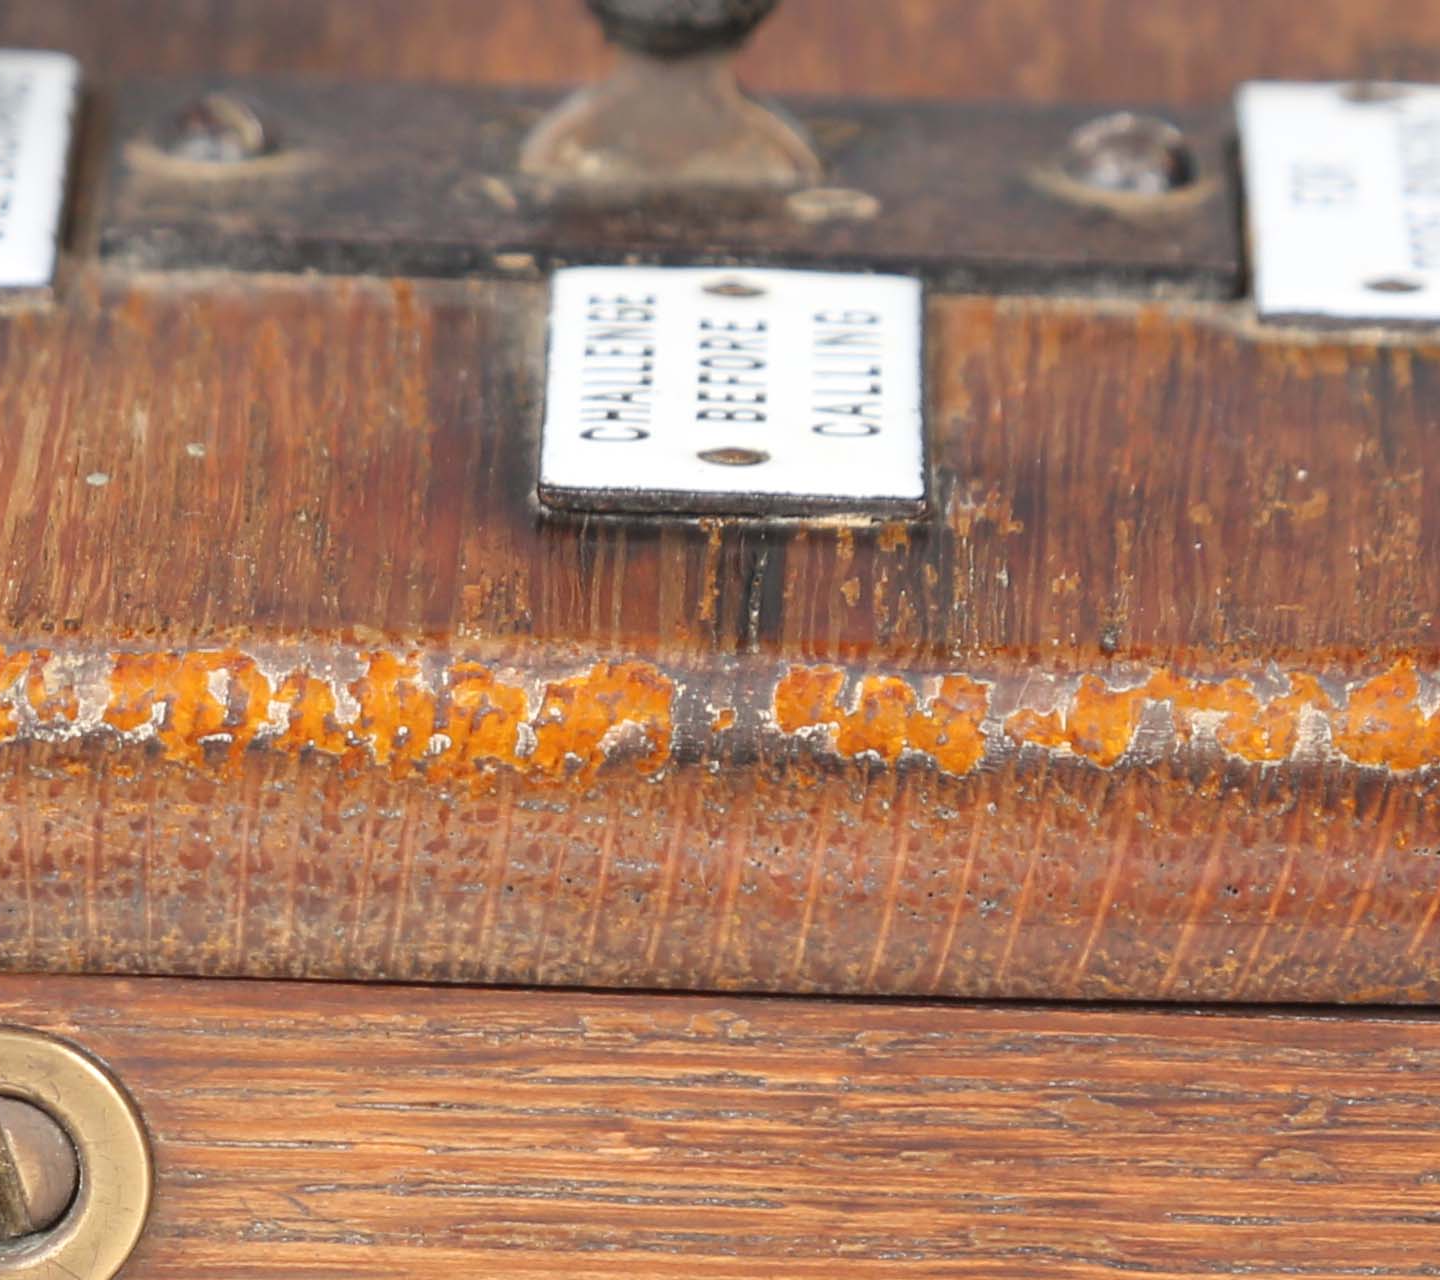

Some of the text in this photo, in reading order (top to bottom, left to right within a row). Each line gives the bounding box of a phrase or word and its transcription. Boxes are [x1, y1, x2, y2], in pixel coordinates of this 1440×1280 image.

[578, 294, 656, 443] CHALLENGE
[696, 318, 769, 423] BEFORE
[811, 309, 883, 438] CALLING
